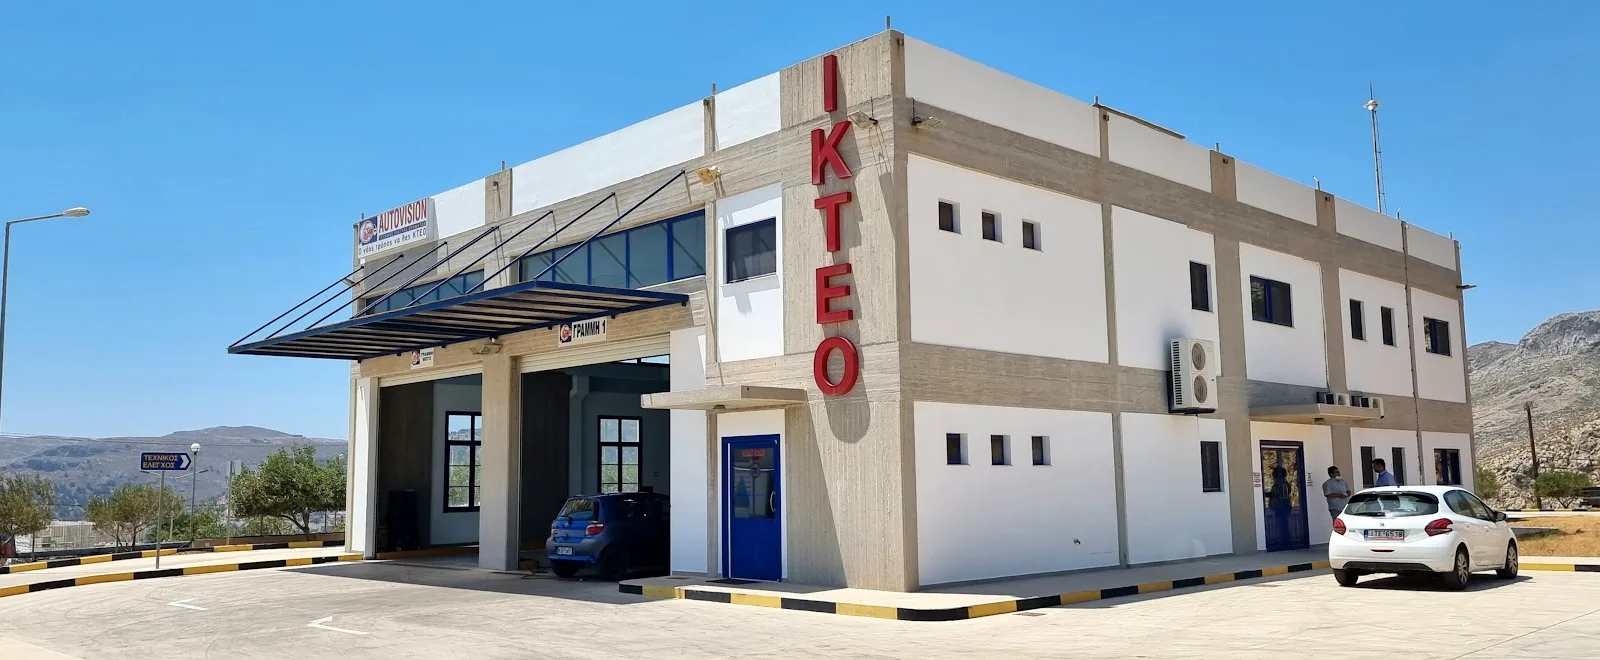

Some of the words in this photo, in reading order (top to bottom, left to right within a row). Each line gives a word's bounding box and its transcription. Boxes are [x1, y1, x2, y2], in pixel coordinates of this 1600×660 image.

[379, 198, 427, 233] AUTOVISION
[811, 54, 859, 396] ΙΚΤΕΟ
[375, 240, 393, 251] τρόπος
[412, 227, 427, 238] ΚΤΕΟ
[573, 320, 600, 338] ΓΡΑΜΜΗ
[602, 319, 606, 334] 1
[142, 461, 176, 469] ΕΛΕΓΧΟΣ
